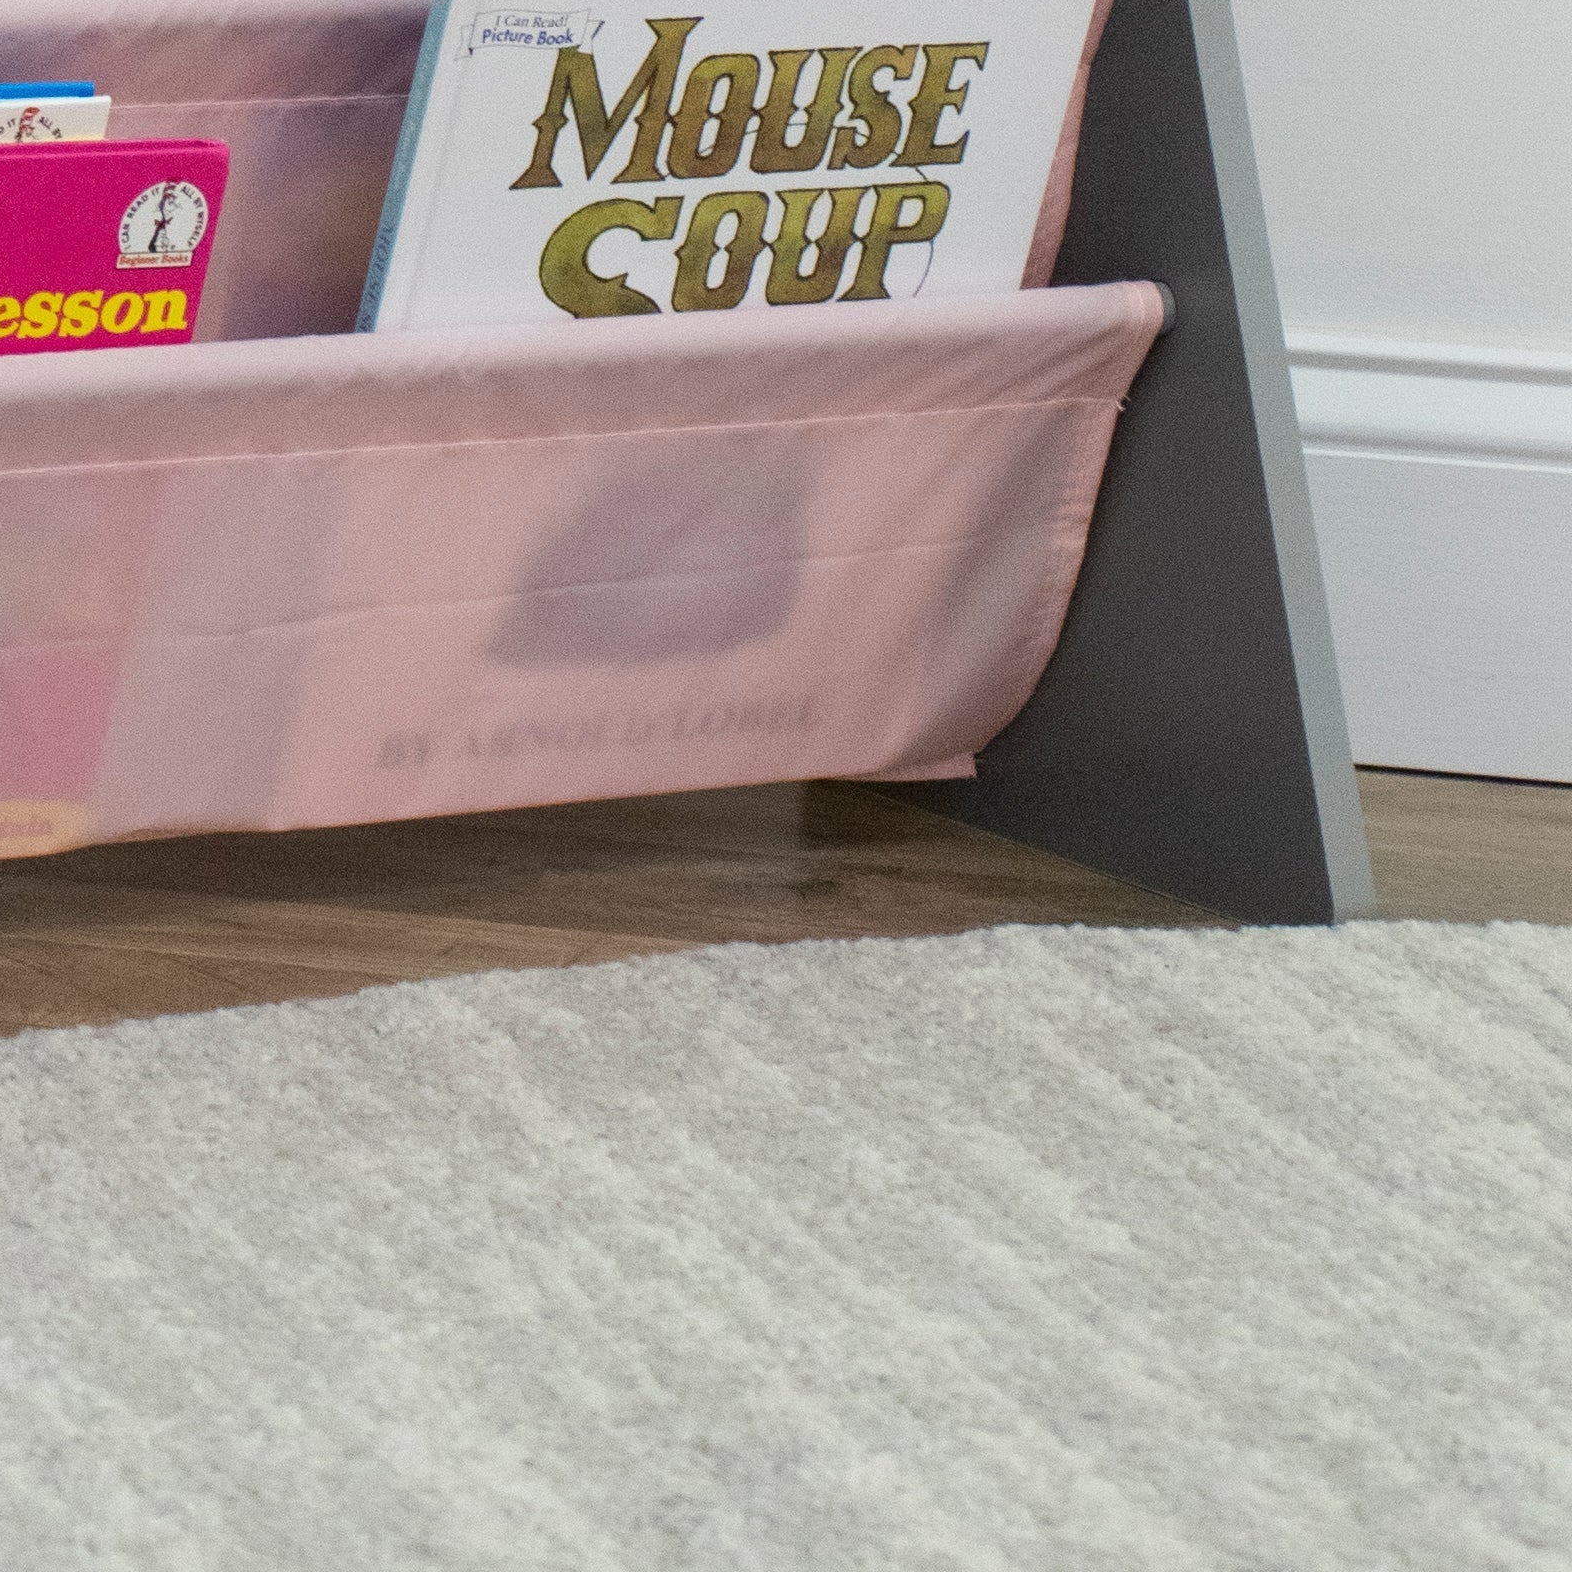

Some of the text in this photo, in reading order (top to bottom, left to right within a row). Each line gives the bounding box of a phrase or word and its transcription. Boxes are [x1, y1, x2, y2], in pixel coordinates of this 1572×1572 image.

[482, 28, 573, 45] Picture Book
[504, 15, 529, 28] Can
[533, 16, 568, 28] Read!
[508, 16, 990, 191] MOUSE
[537, 181, 952, 319] COUP
